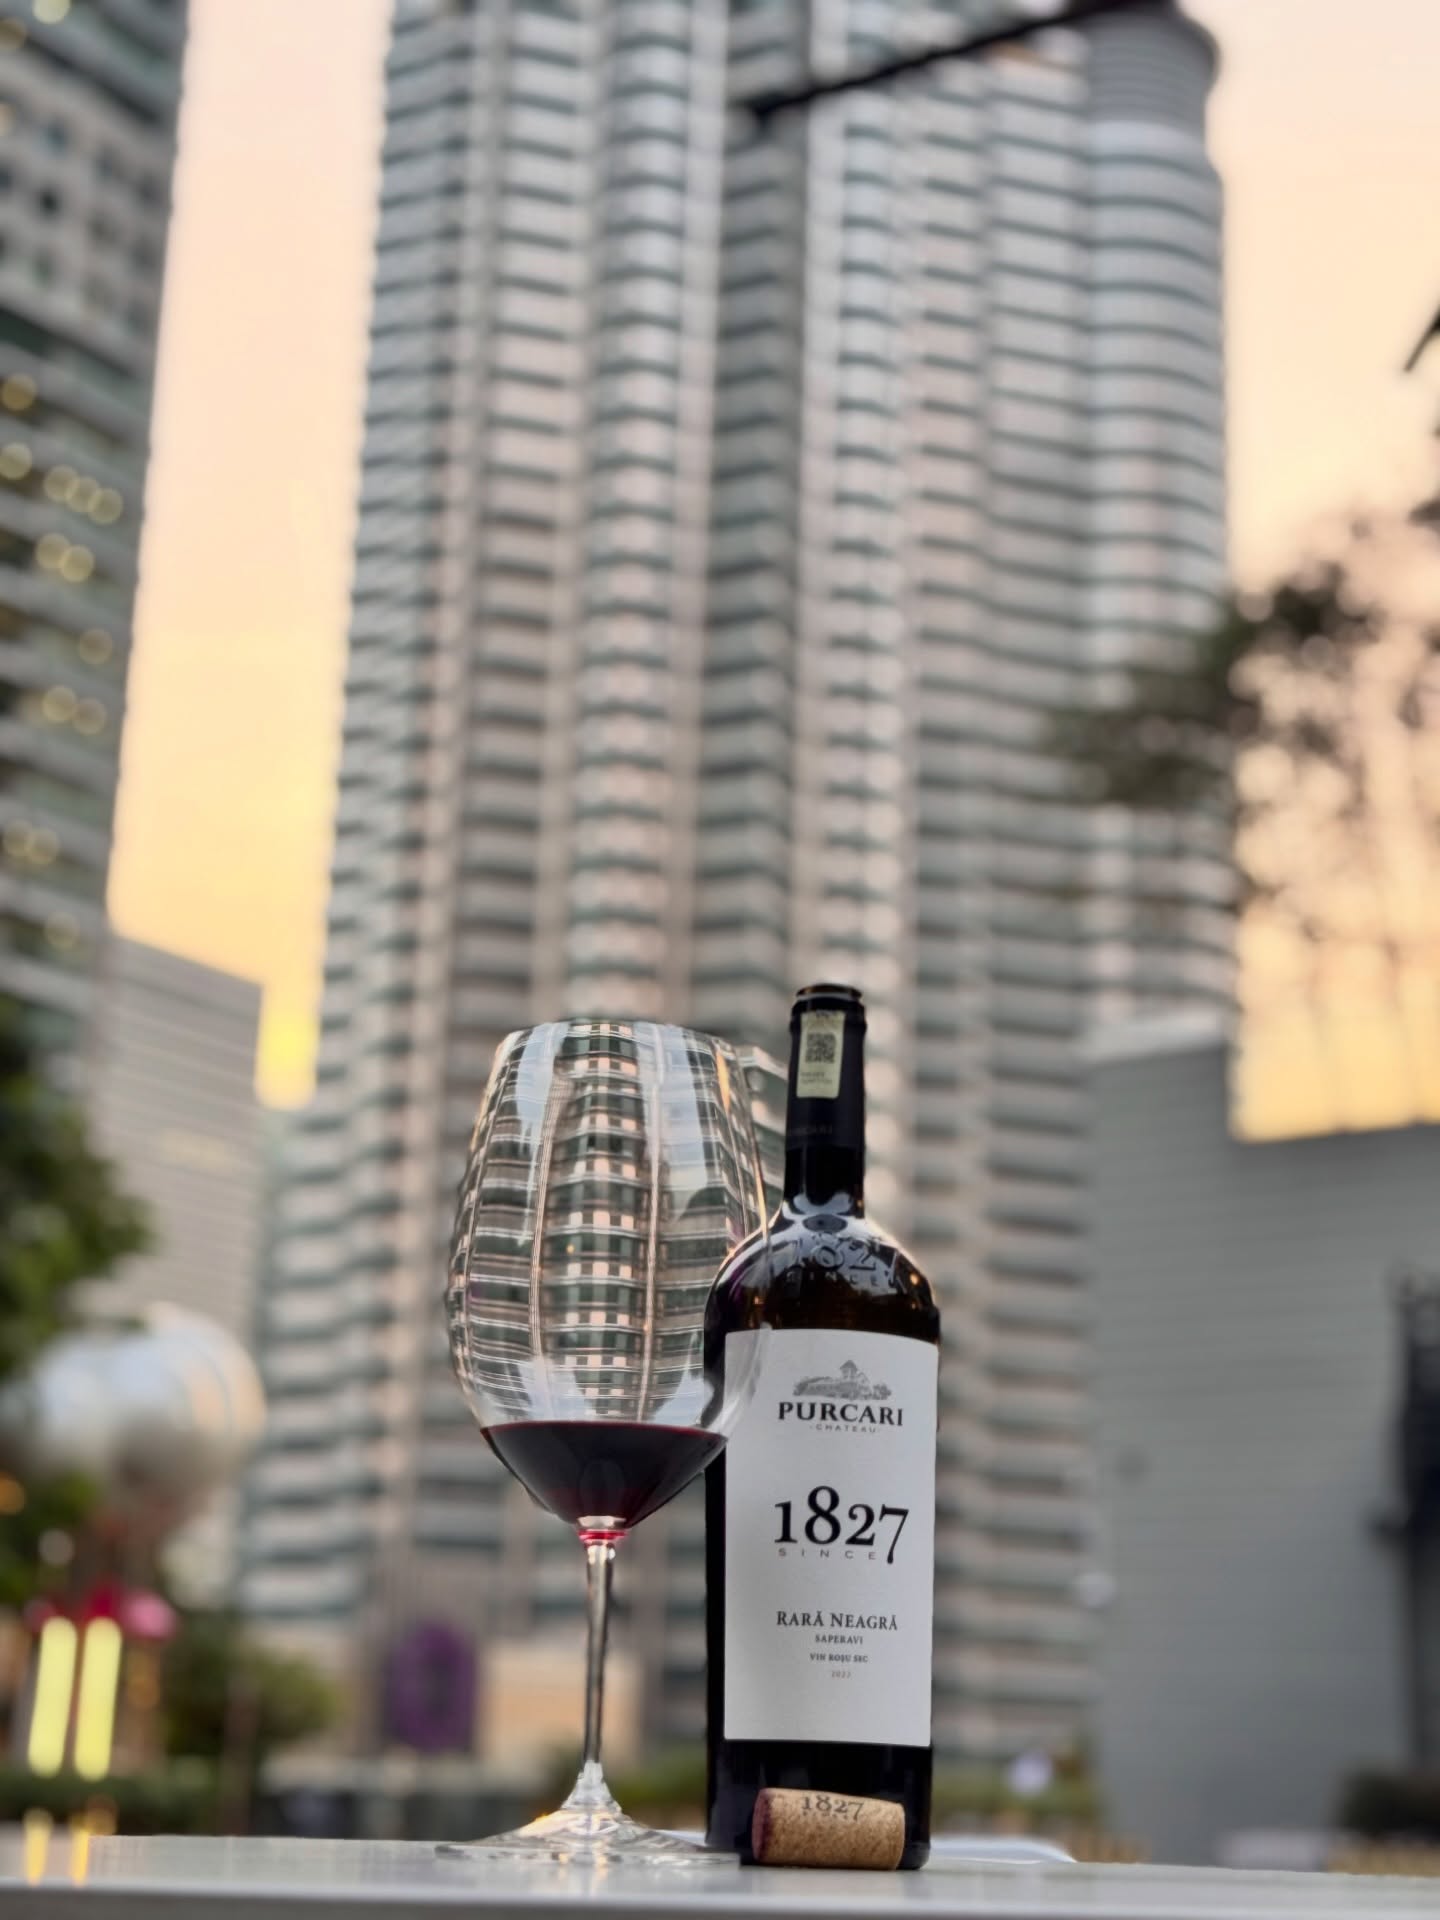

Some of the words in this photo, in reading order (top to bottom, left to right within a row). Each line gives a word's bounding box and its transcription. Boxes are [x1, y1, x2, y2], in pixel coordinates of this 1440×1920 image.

[778, 1401, 903, 1427] PURCARI
[816, 1424, 877, 1433] CHATEAU
[774, 1485, 910, 1565] 1827
[779, 1548, 876, 1561] SINCE
[776, 1611, 824, 1627] RARĂ
[815, 1634, 864, 1645] SAPERAVI
[853, 1654, 869, 1663] SEC
[801, 1795, 864, 1821] 1827
